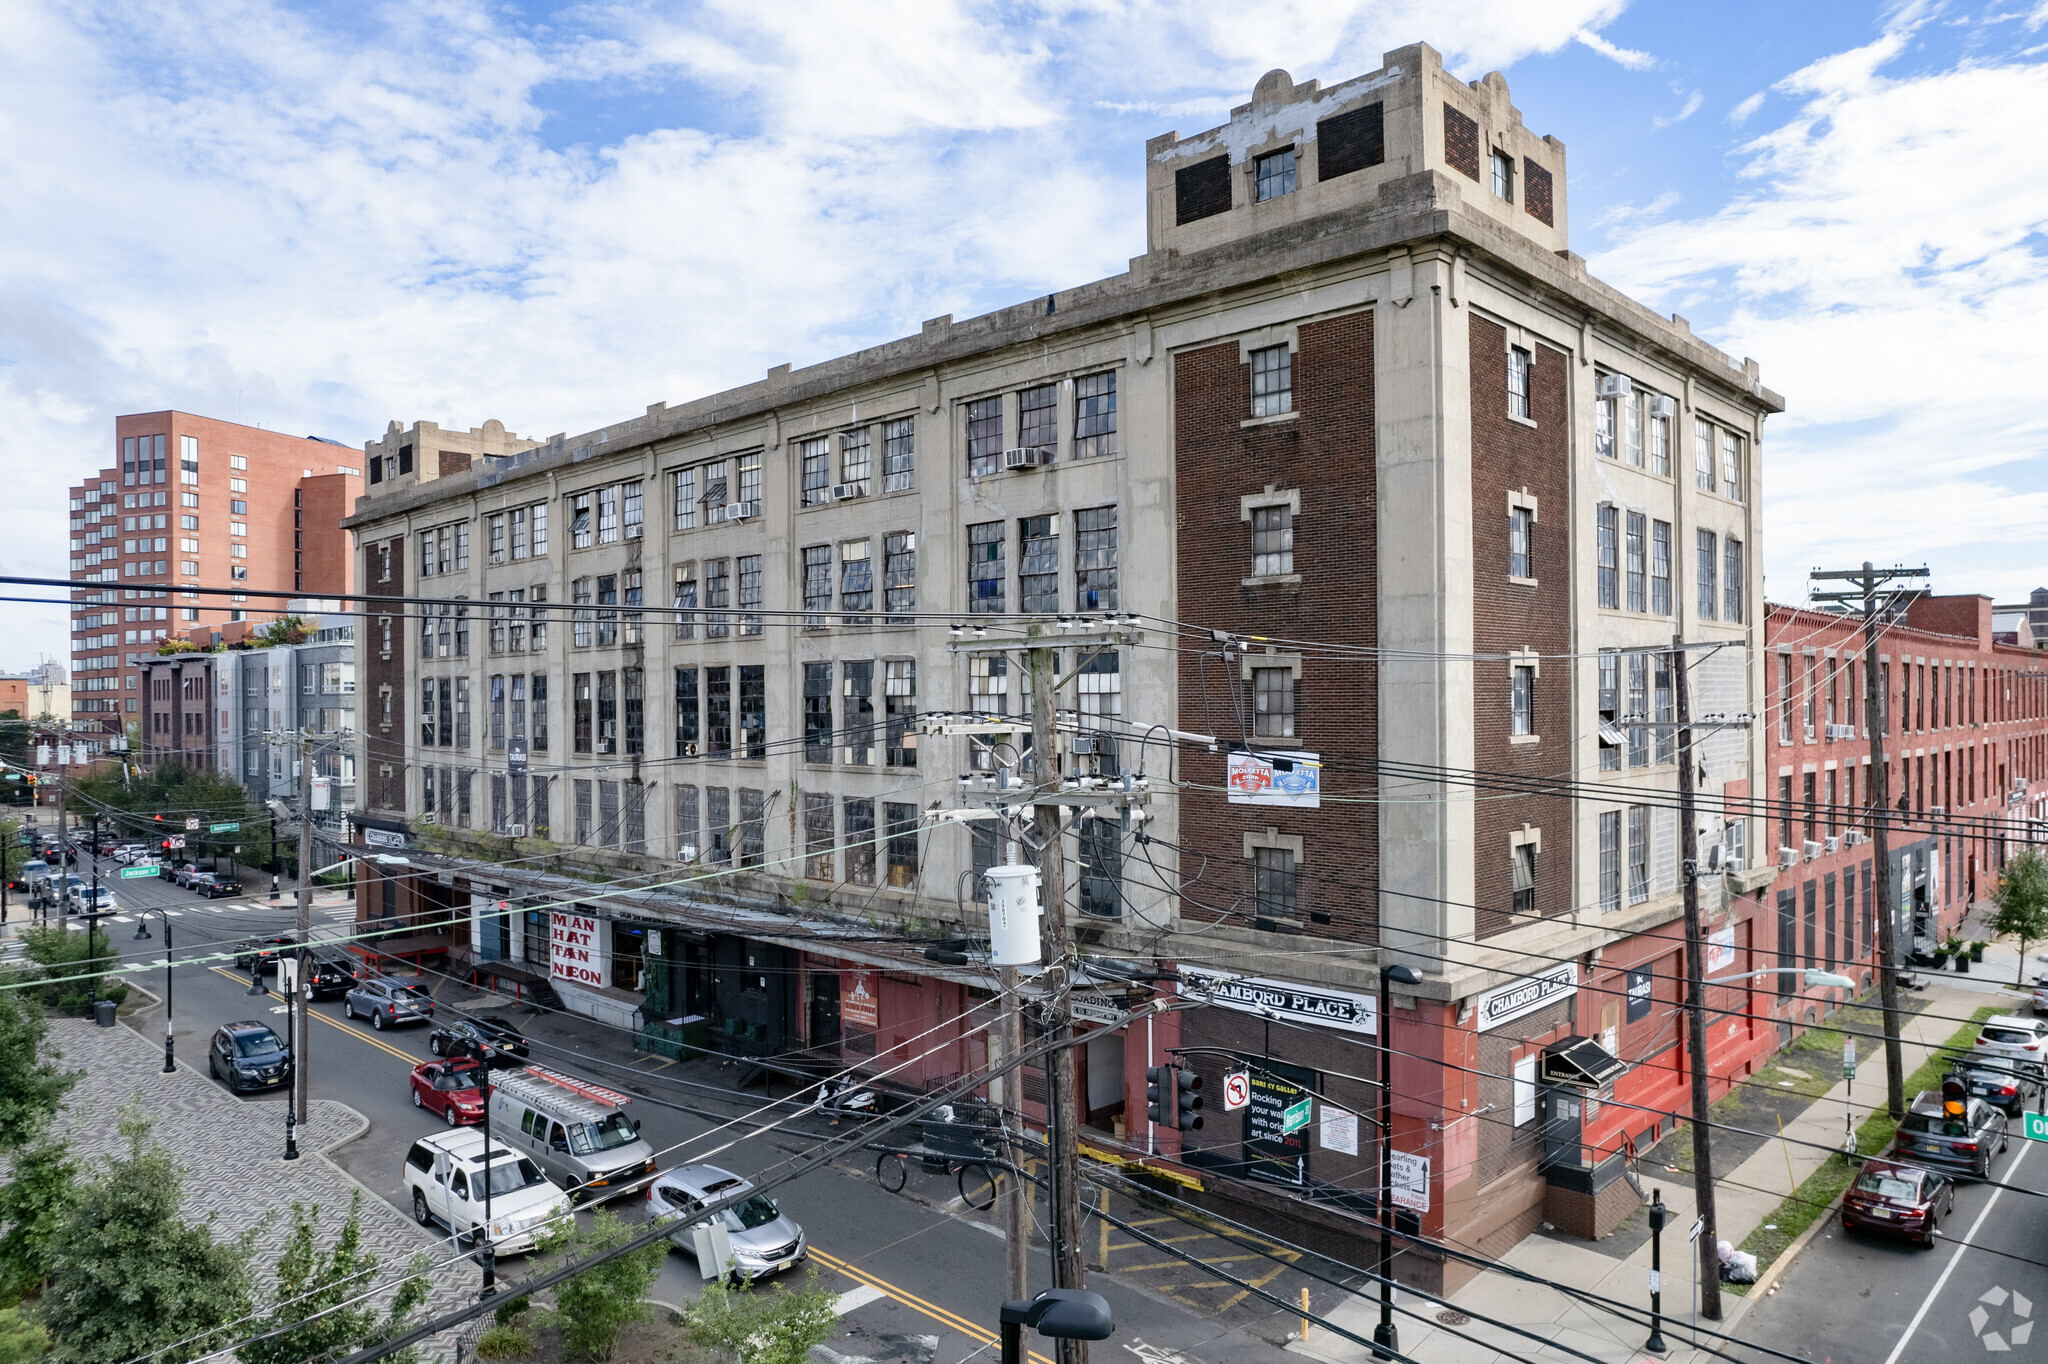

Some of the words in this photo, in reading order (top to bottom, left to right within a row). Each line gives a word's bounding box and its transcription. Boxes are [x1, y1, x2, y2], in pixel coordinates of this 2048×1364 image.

[124, 869, 149, 877] Jackson
[553, 913, 595, 933] MAN
[553, 928, 591, 947] HAT
[552, 943, 589, 963] TAN
[553, 961, 602, 985] NEON
[1491, 984, 1540, 1016] CHAMBORD
[1541, 973, 1569, 996] PLACE
[1291, 996, 1350, 1019] PLACE
[1251, 1091, 1282, 1108] Rocking
[1251, 1105, 1269, 1115] your
[1251, 1117, 1268, 1127] with
[1286, 1110, 1304, 1129] Harrison
[1251, 1129, 1262, 1138] art
[1263, 1131, 1283, 1144] since
[1391, 1153, 1417, 1166] earling
[1391, 1163, 1404, 1171] ats
[1391, 1172, 1410, 1181] ather
[1391, 1180, 1411, 1191] ckets
[1391, 1194, 1426, 1210] EARANCE
[1411, 1193, 1426, 1202] FINAL
